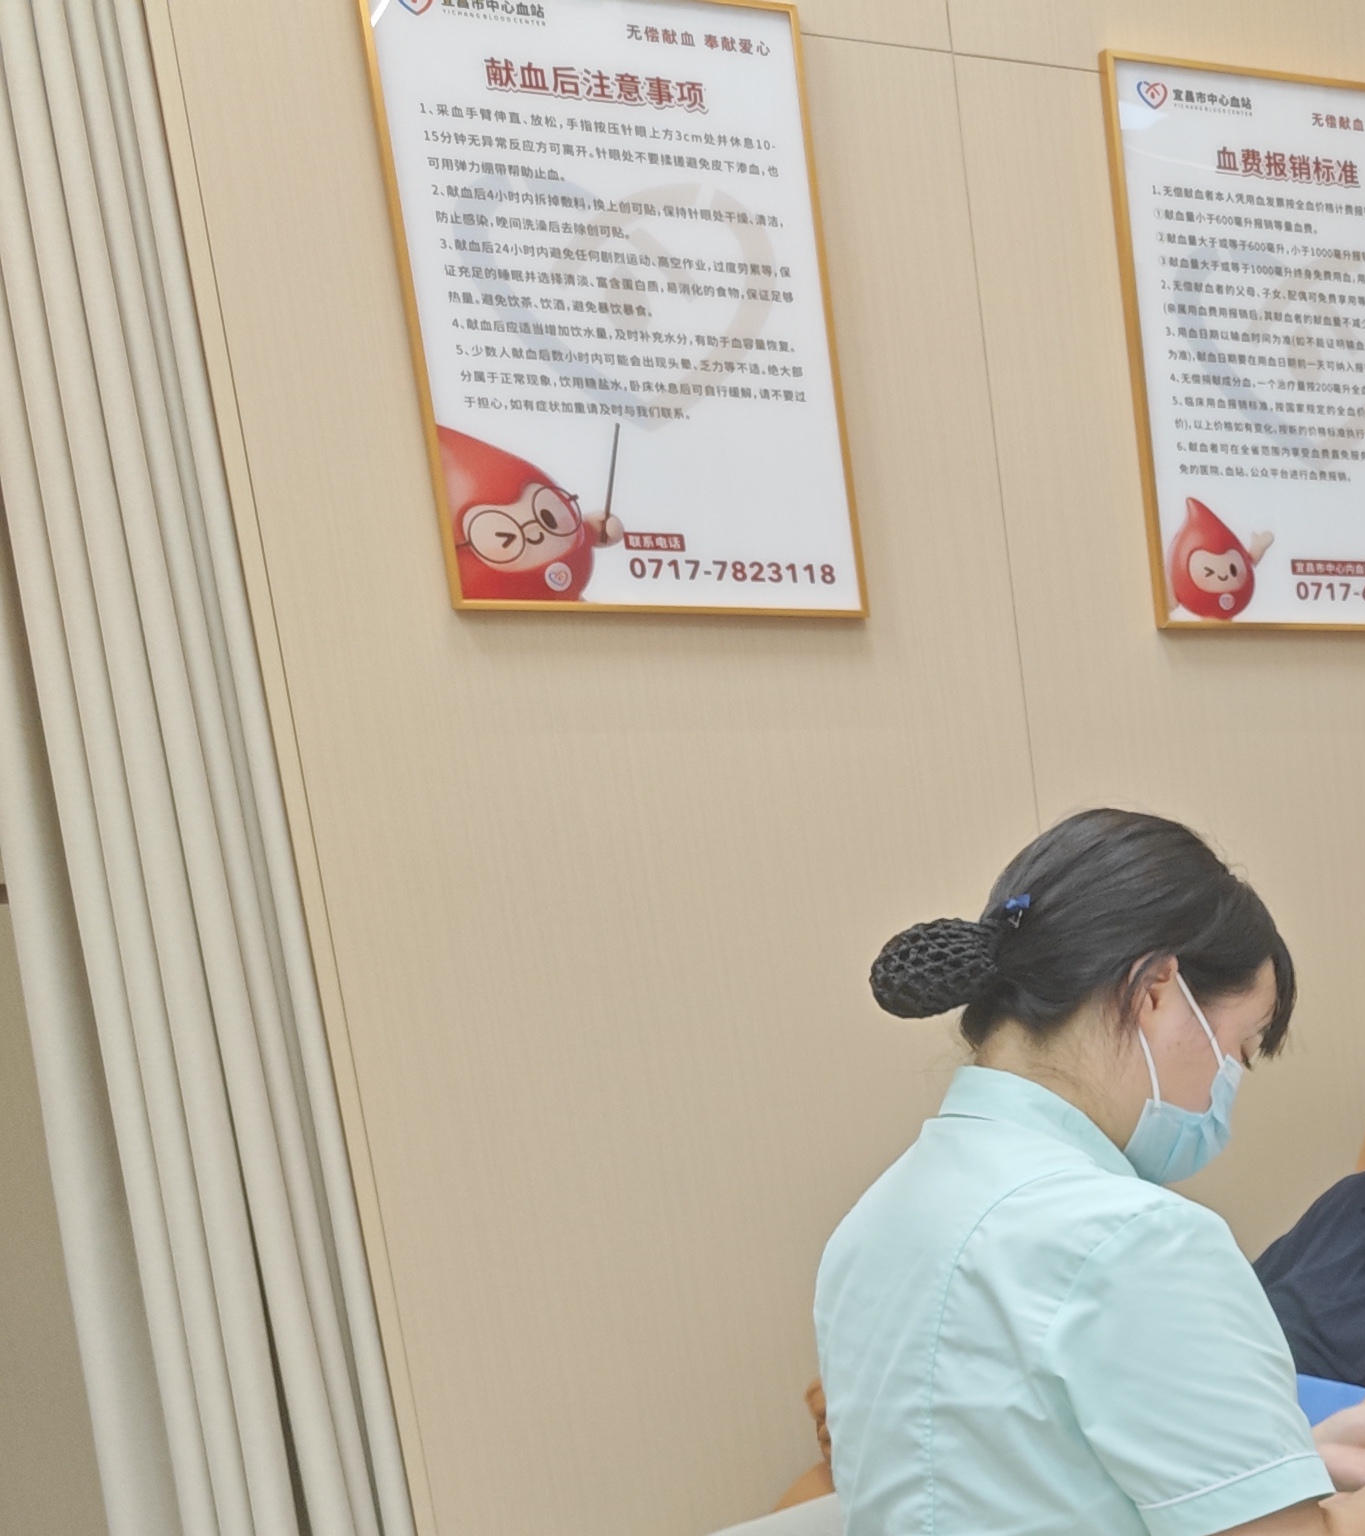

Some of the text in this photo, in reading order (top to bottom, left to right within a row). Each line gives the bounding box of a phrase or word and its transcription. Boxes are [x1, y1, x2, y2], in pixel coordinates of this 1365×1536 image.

[626, 24, 771, 56] 无偿献血 奉献爱心
[484, 57, 706, 110] 献血后注意事项
[1173, 89, 1251, 110] 宜昌市中心血站
[1311, 112, 1364, 132] 无偿献血
[1216, 146, 1360, 185] 血费报销标准
[628, 535, 681, 550] 联系电话
[629, 557, 836, 585] 0717-7823118
